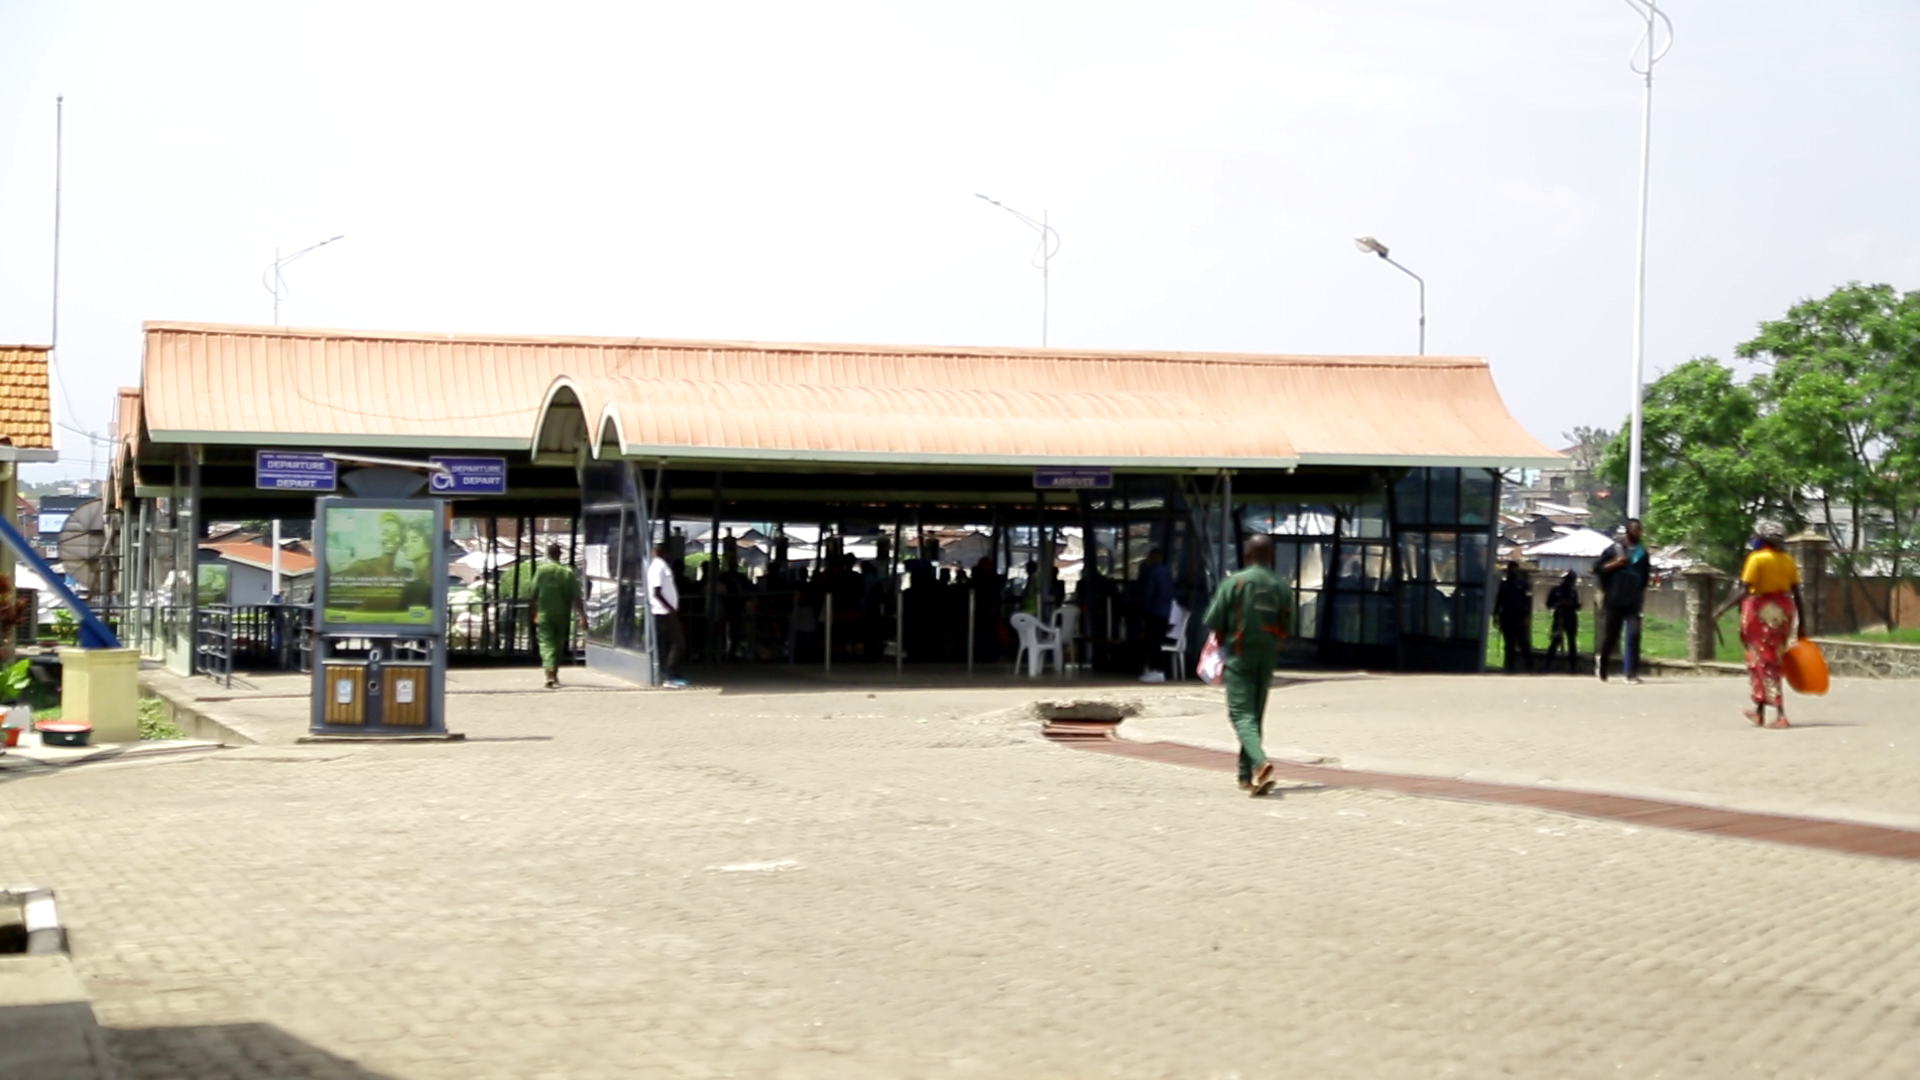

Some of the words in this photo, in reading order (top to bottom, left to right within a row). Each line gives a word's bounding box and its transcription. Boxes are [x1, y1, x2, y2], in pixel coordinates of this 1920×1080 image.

[267, 460, 325, 470] DEPARTURE
[451, 465, 501, 473] DEPARTURE
[276, 479, 317, 488] DEPART
[463, 476, 501, 485] DEPART
